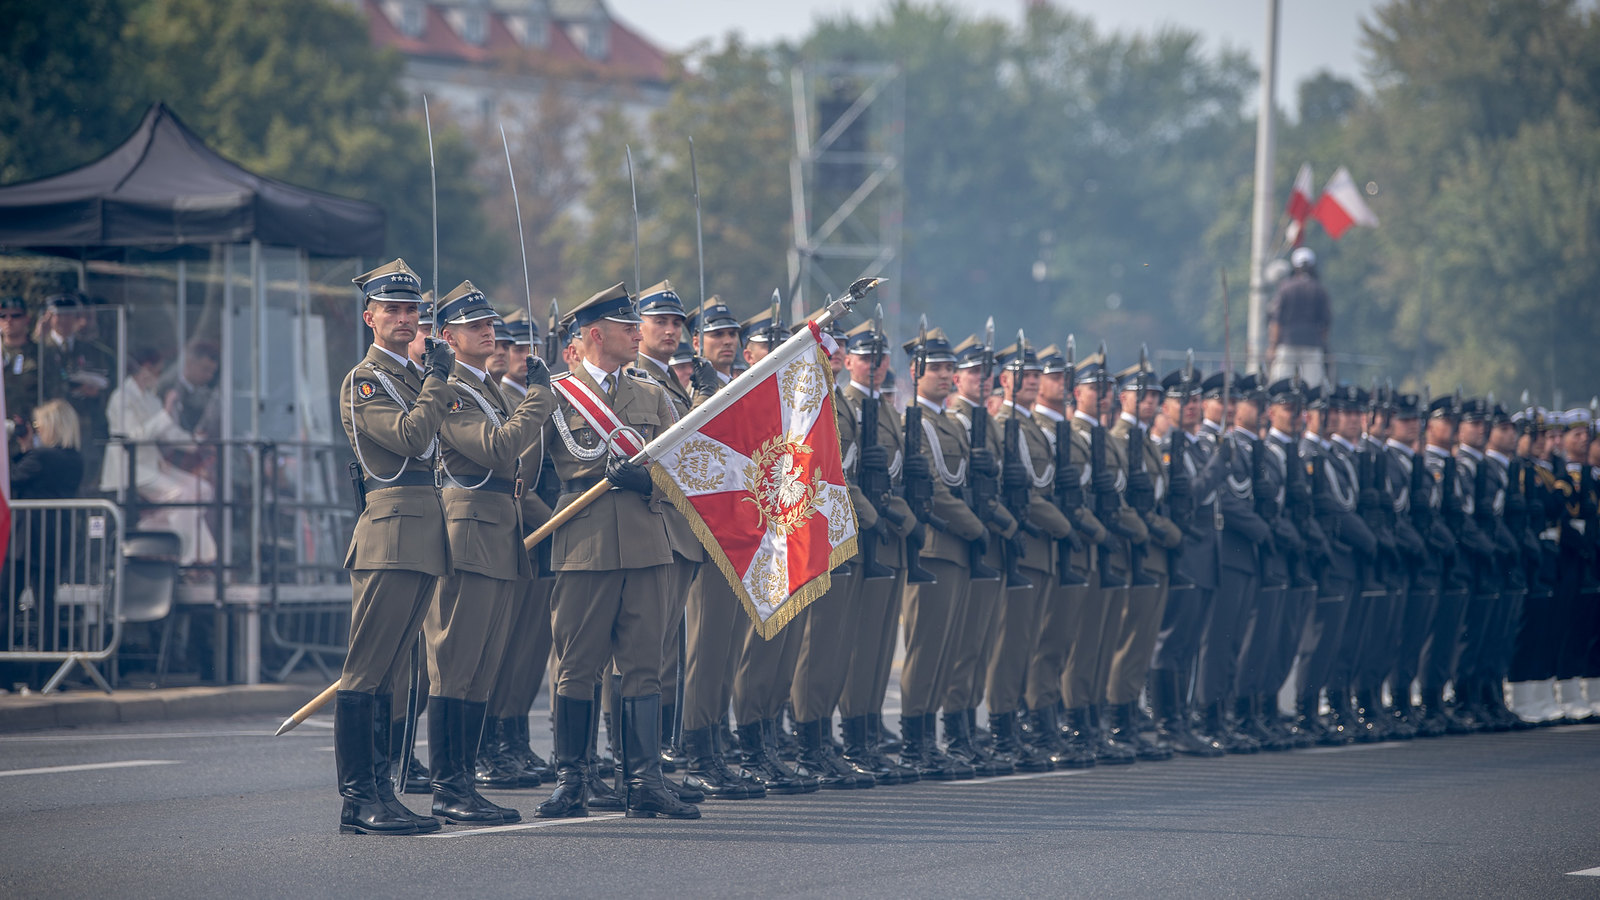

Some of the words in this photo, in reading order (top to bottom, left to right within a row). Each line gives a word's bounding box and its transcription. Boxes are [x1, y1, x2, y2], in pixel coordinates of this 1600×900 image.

[797, 374, 812, 385] WP
[689, 456, 699, 473] WP
[762, 581, 775, 592] WP
